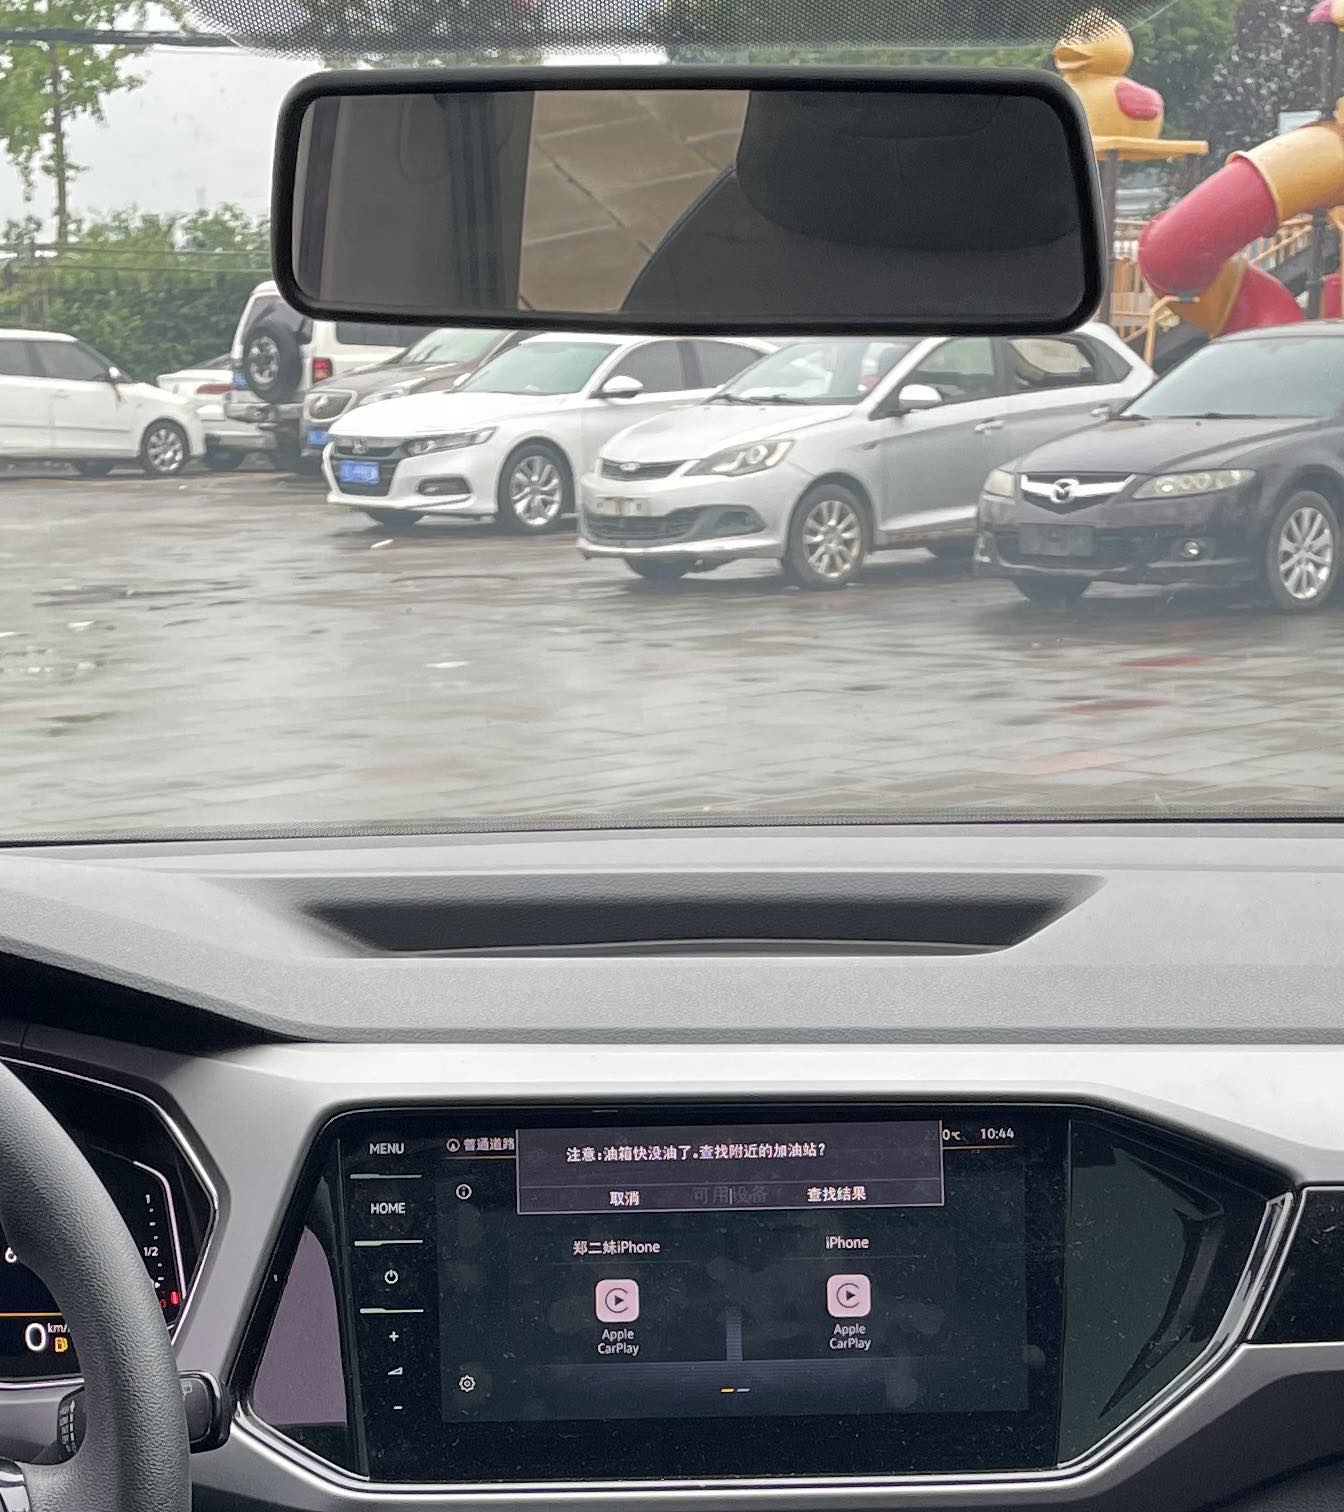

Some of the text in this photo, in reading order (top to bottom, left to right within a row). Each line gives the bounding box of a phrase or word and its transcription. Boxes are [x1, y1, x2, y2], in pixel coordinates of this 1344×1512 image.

[980, 1128, 1014, 1140] 10:44
[369, 1142, 405, 1155] MENU
[609, 1190, 640, 1206] 取消
[807, 1186, 867, 1203] 查找结果
[370, 1202, 406, 1215] HOME
[825, 1236, 870, 1250] iPhone
[143, 1246, 159, 1257] 1/2
[24, 1322, 70, 1351] 0 km/
[602, 1329, 635, 1342] Apple
[834, 1323, 866, 1337] Apple
[597, 1342, 639, 1357] CarPlay
[829, 1338, 872, 1352] CarPlay
